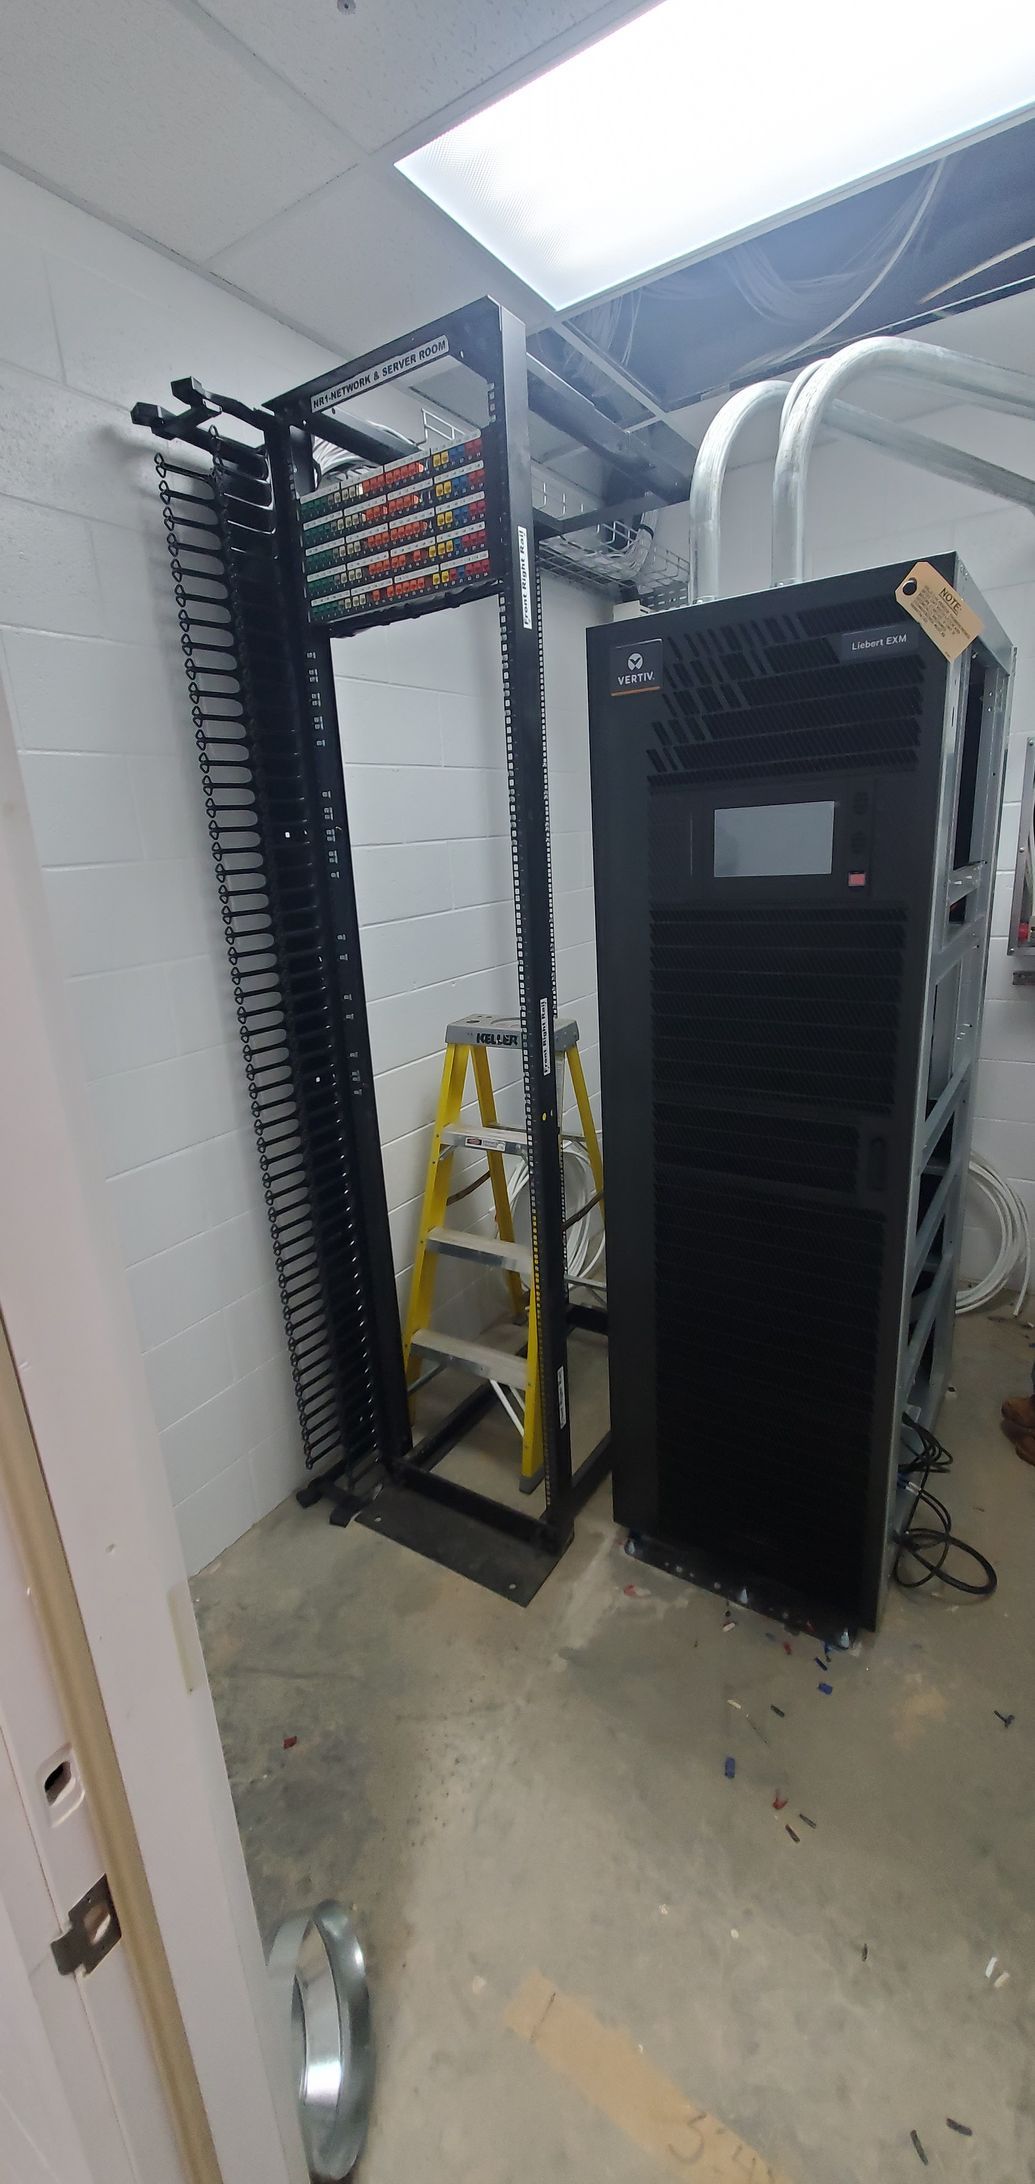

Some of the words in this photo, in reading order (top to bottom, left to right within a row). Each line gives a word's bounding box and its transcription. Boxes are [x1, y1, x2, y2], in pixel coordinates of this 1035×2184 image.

[373, 370, 380, 381] &
[382, 354, 417, 377] SERVER
[419, 340, 446, 361] ROOM
[518, 530, 526, 555] Rail
[520, 556, 528, 590] Right
[940, 587, 962, 612] NOTE
[852, 639, 884, 651] Liebert
[886, 633, 907, 645] EXM
[617, 671, 654, 686] VERTIV
[476, 1032, 518, 1046] KELLER
